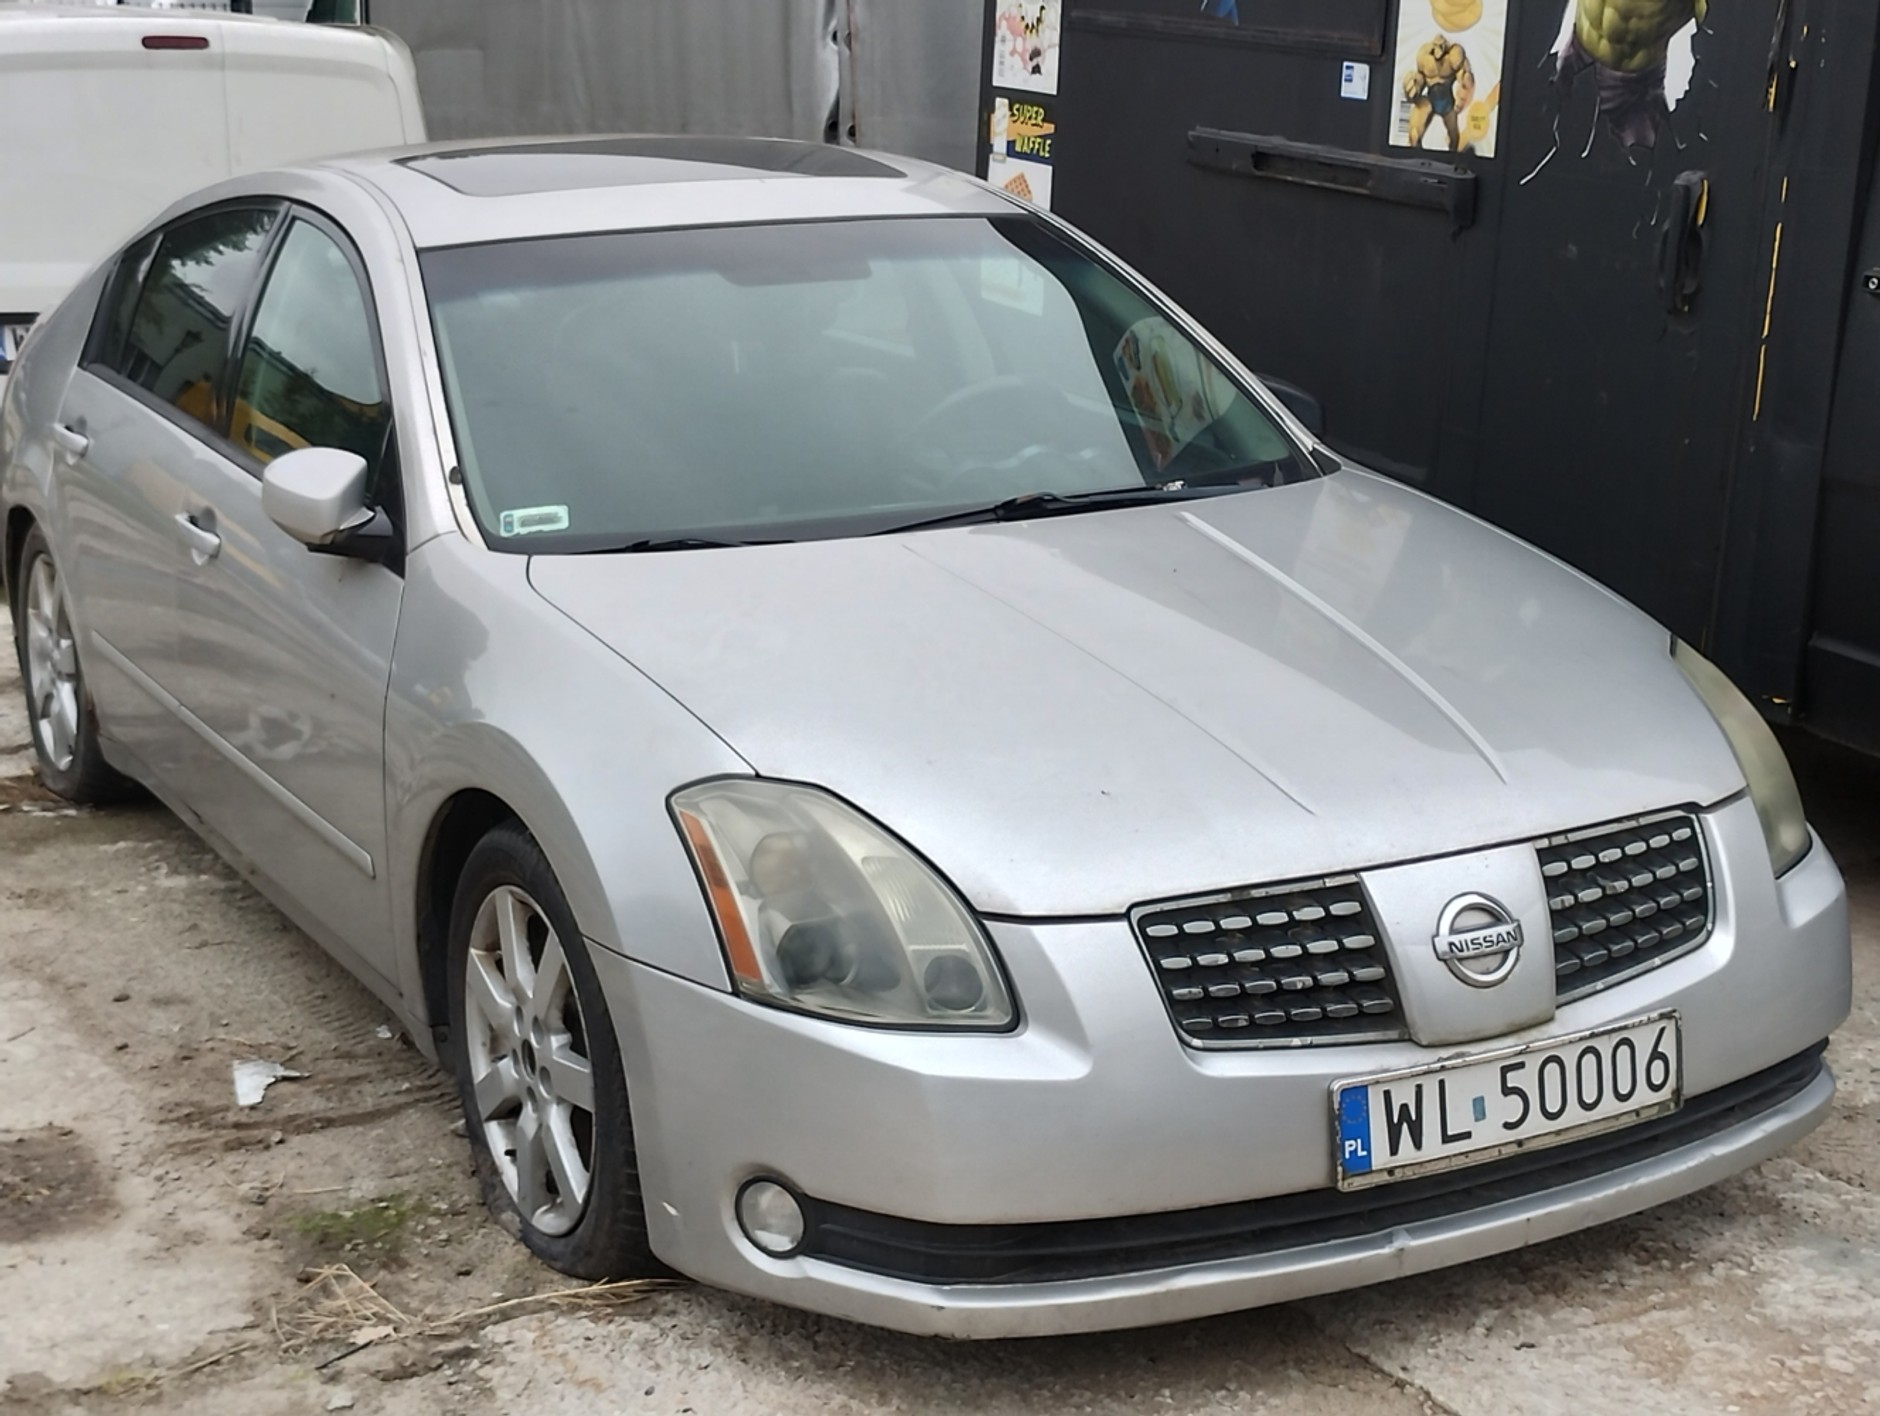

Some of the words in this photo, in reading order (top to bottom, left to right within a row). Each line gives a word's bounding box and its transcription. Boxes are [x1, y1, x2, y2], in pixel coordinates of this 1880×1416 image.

[1011, 103, 1045, 127] SUPER
[1014, 134, 1052, 158] WAFFLE
[1447, 927, 1518, 954] NISSAN
[1382, 1078, 1472, 1157] WL
[1499, 1025, 1671, 1131] 50006
[1343, 1138, 1368, 1160] PL
